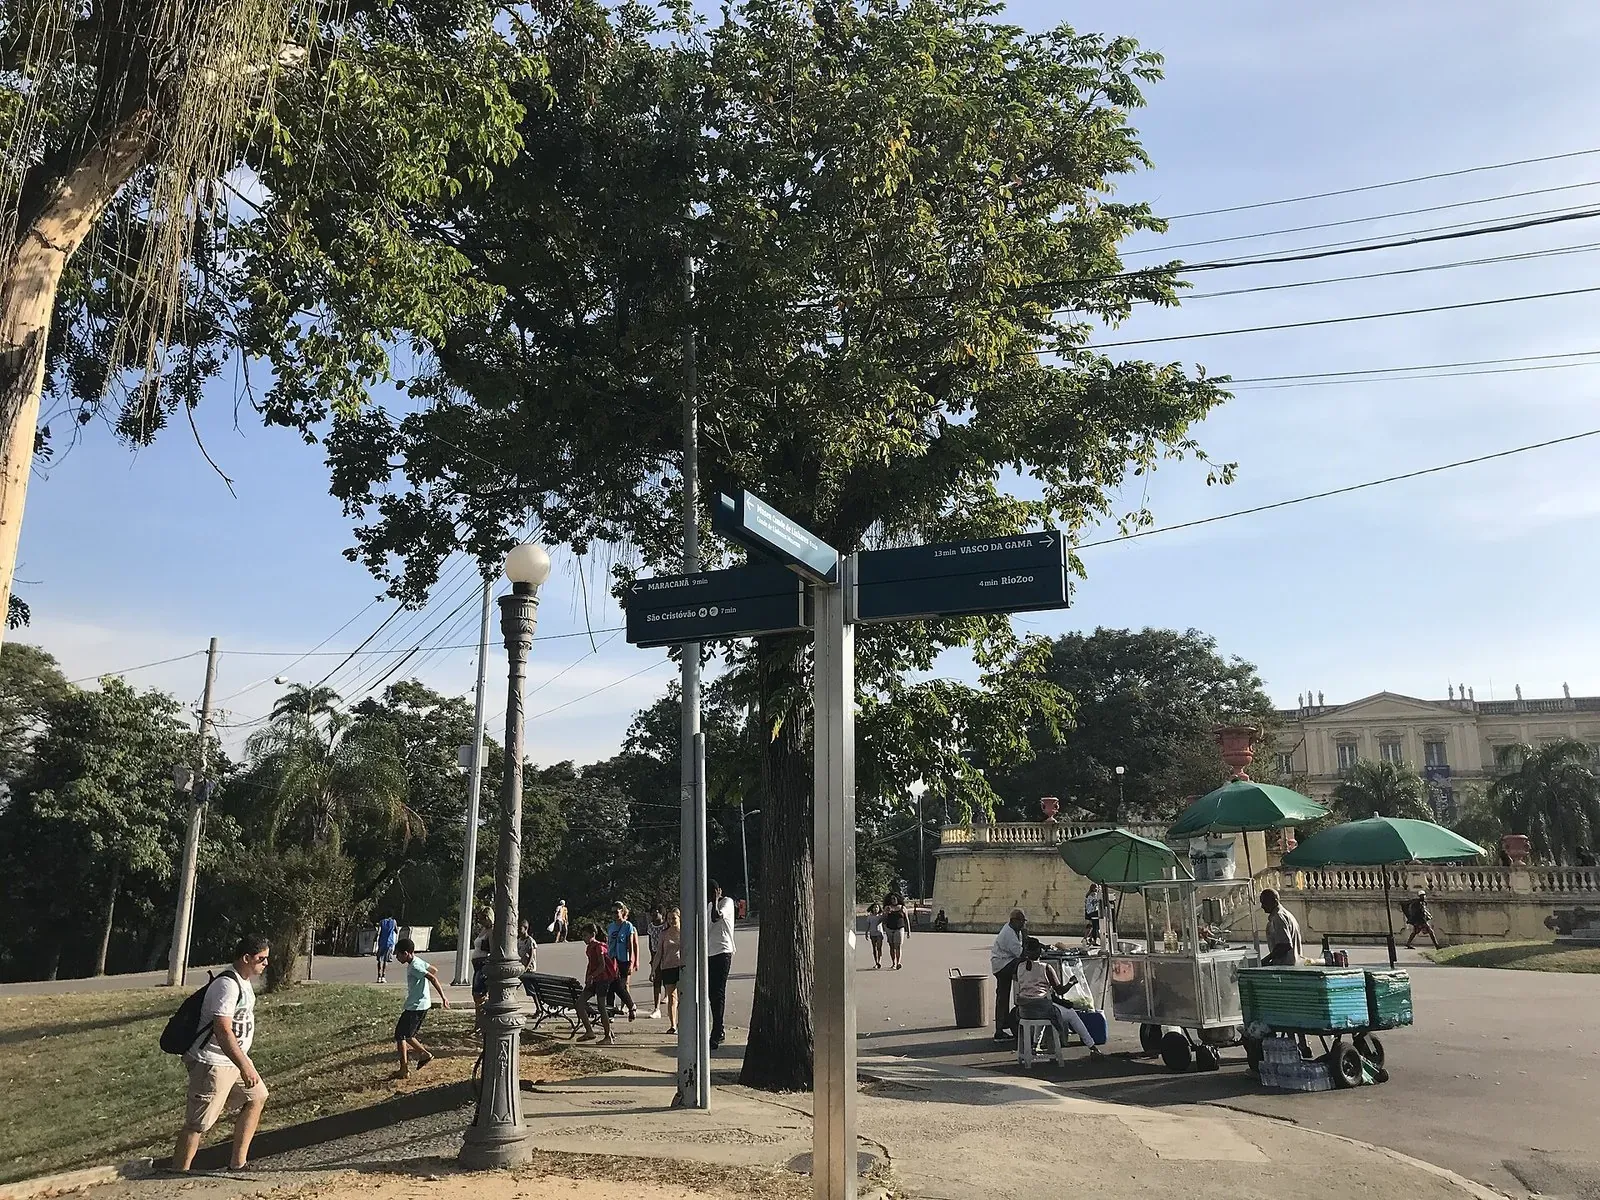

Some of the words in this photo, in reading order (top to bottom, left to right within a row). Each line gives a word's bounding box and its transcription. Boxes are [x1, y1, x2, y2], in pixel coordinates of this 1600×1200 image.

[934, 548, 957, 558] 13min
[960, 544, 989, 555] VASCO
[990, 543, 1003, 552] DA
[1004, 539, 1033, 550] GAMA
[647, 577, 690, 591] MARACANÃ
[692, 577, 709, 586] 9min
[979, 579, 998, 587] 4min
[1001, 575, 1034, 585] RioZoo
[646, 612, 661, 622] São
[661, 609, 697, 621] Cristóvão
[720, 606, 737, 615] 7min
